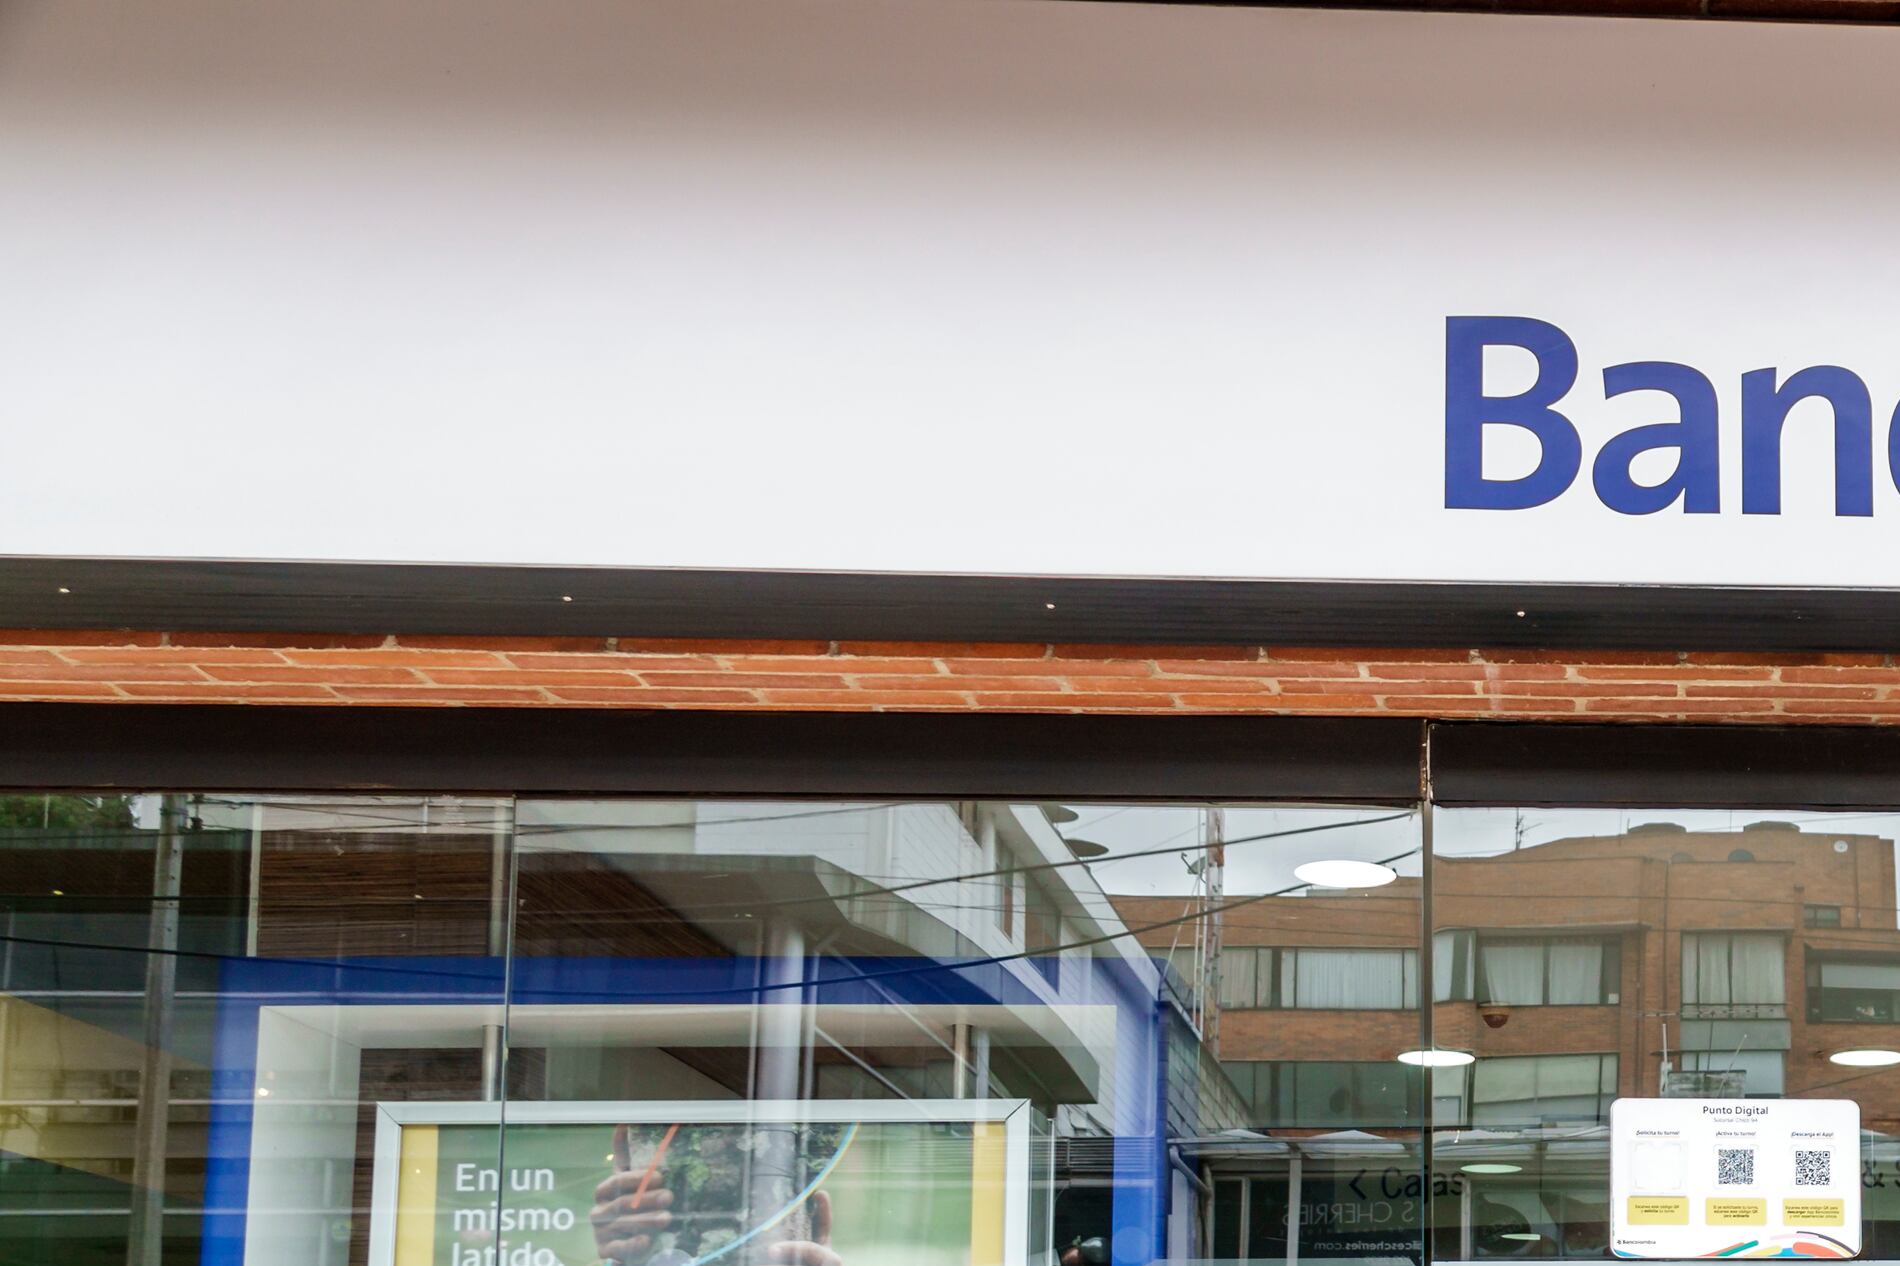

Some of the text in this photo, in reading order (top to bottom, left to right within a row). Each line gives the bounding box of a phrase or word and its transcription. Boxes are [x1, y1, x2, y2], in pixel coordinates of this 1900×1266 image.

[1702, 1105, 1769, 1117] Punto Digital
[456, 1163, 554, 1192] En un
[453, 1201, 575, 1231] mismo
